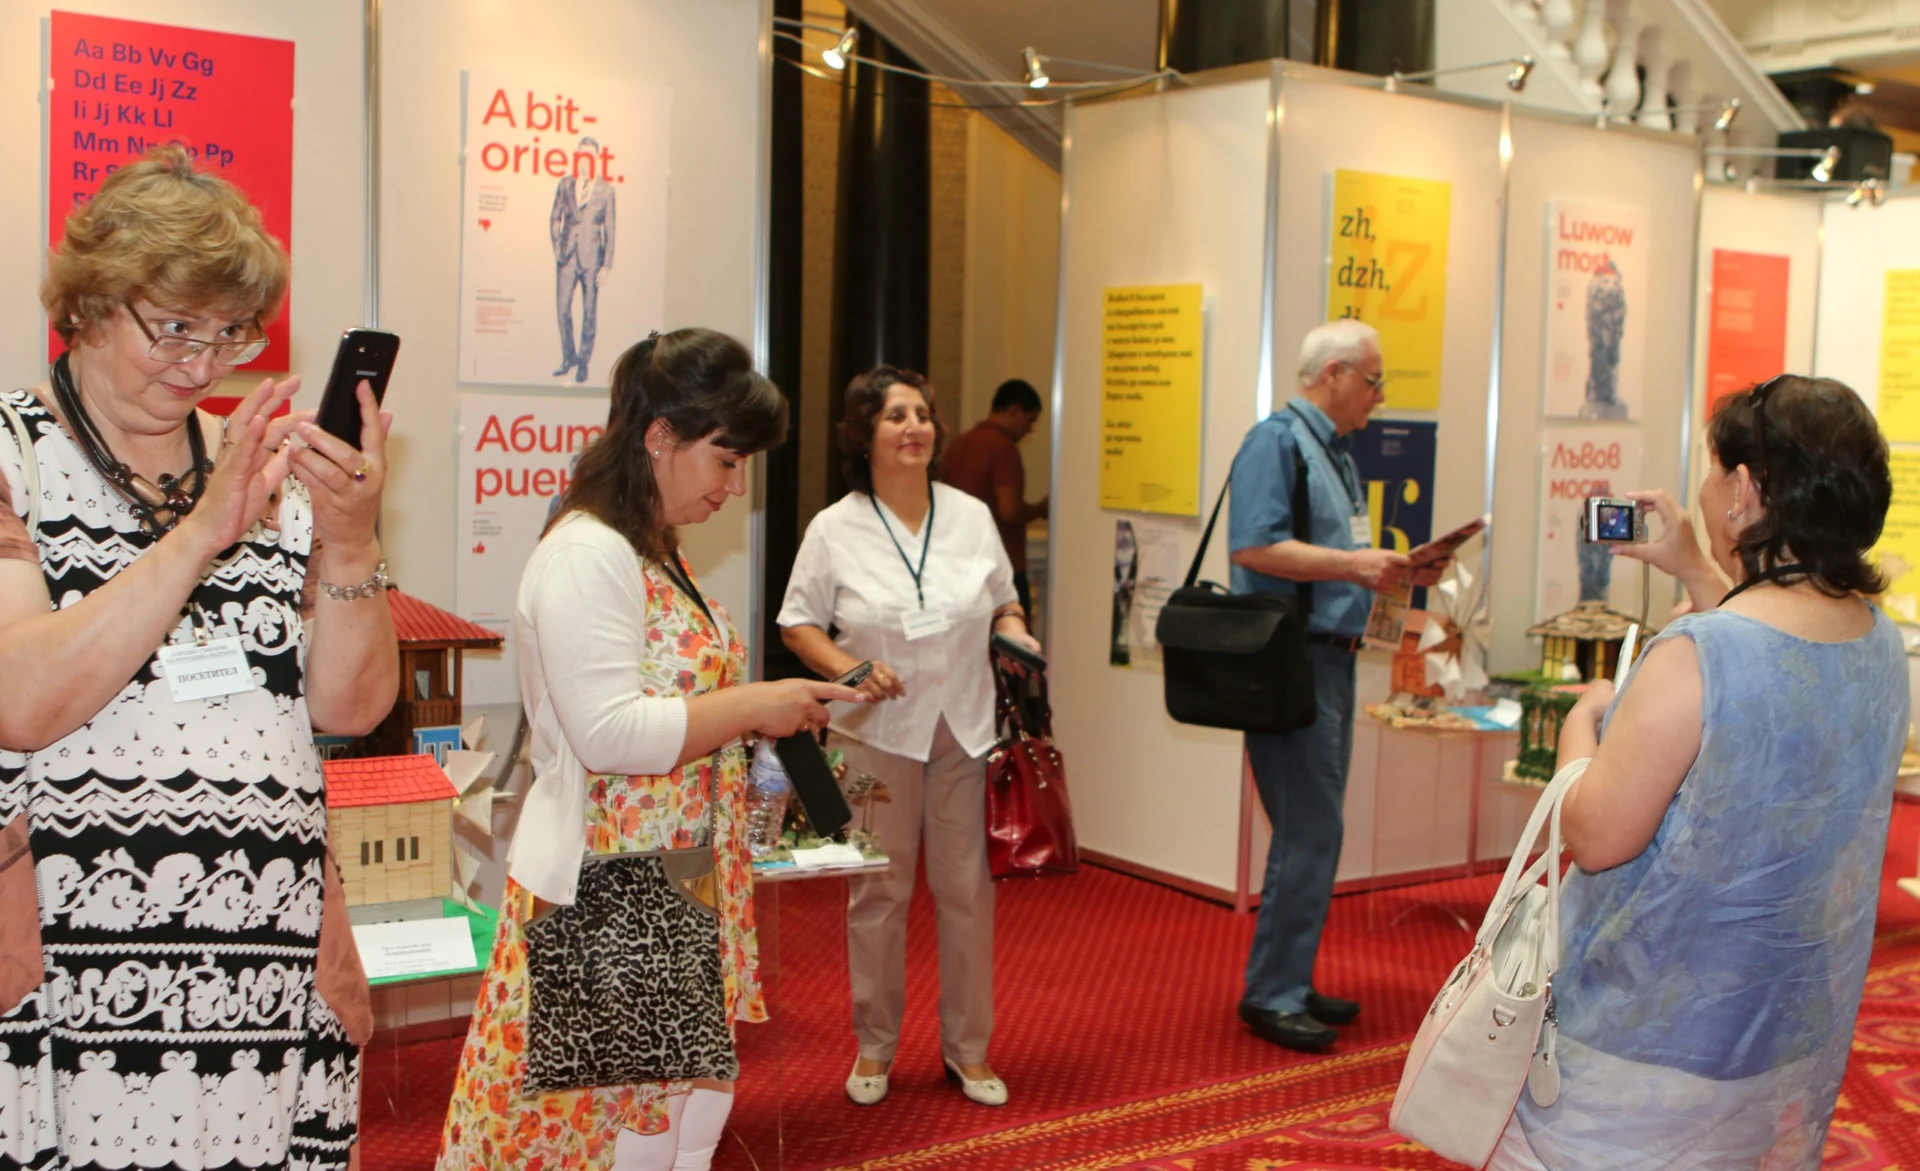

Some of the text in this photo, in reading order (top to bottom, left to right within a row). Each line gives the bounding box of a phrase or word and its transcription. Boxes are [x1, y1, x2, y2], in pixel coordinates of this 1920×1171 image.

[74, 38, 214, 77] Aa Bb Vv Gg
[74, 69, 197, 101] Dd Ee Jj Zz
[94, 101, 110, 126] Jj
[118, 104, 146, 126] Kk
[154, 108, 173, 129] Ll
[482, 88, 597, 135] A bit-
[73, 131, 119, 154] Mm
[205, 143, 234, 167] Pp
[480, 137, 626, 184] orient.
[73, 161, 99, 182] Rr
[1339, 207, 1377, 243] zh,
[1559, 212, 1635, 248] Luwow
[1337, 256, 1391, 292] dzh,
[177, 667, 238, 682] ПОСЕТИТЕЛ
